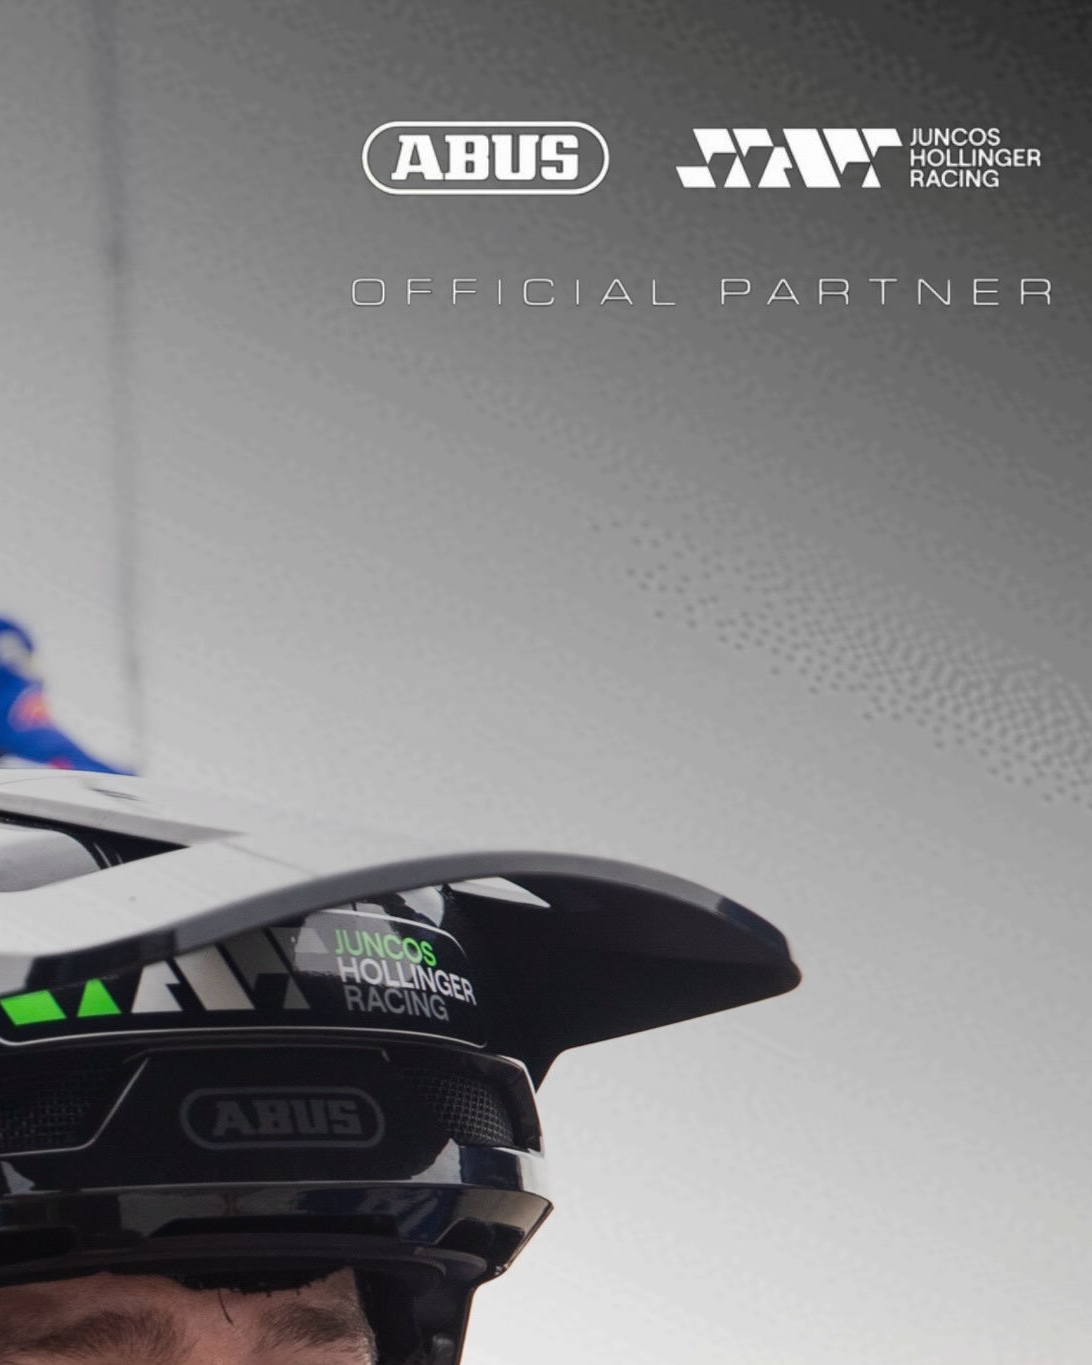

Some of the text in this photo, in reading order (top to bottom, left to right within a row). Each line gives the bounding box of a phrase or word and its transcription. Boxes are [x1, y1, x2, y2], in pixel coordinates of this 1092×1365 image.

[335, 928, 437, 967] JUNCOS
[337, 956, 477, 1006] HOLLINGER
[343, 984, 449, 1021] RACING
[211, 1100, 363, 1136] ABUS
